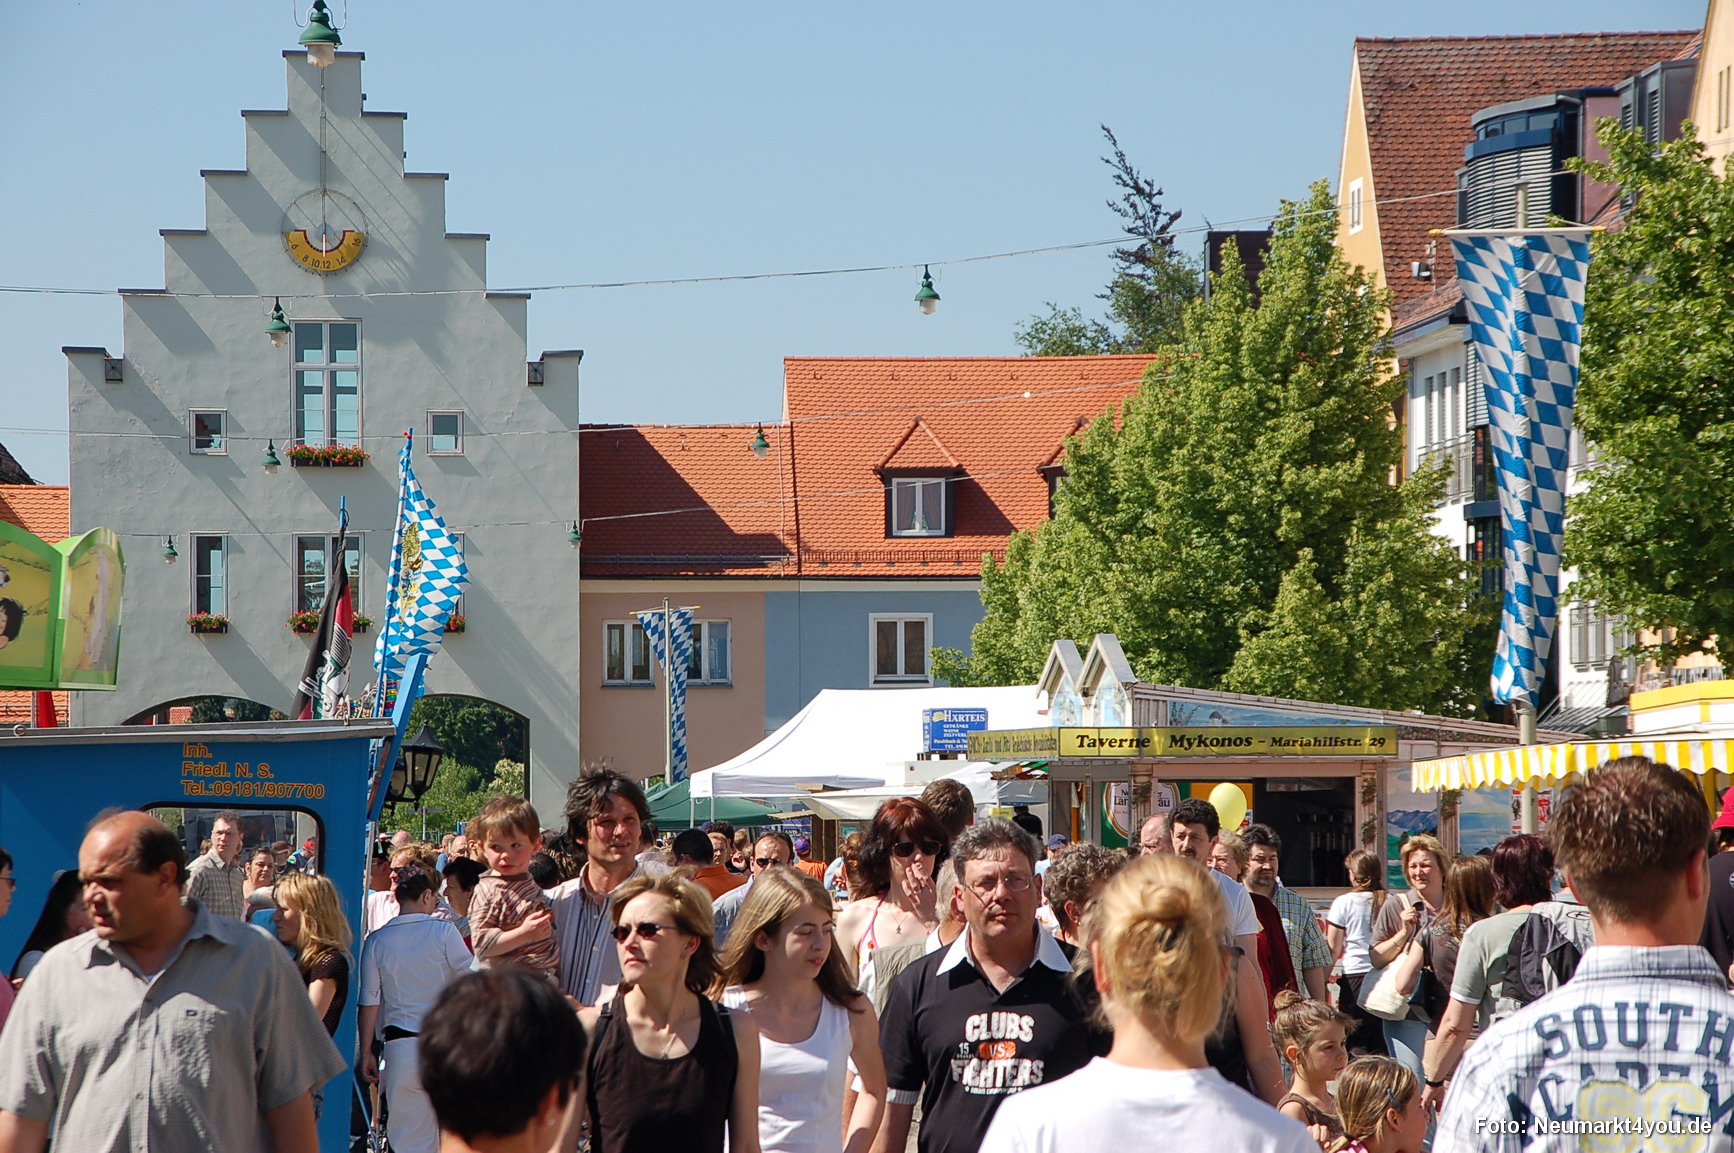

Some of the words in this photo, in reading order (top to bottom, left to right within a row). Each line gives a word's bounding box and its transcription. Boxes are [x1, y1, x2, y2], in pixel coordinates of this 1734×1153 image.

[302, 254, 309, 262] 8
[310, 258, 320, 268] 10
[322, 260, 331, 269] 12
[336, 256, 346, 266] 14
[352, 237, 361, 247] 16
[183, 742, 212, 758] Inh.
[1076, 734, 1150, 748] Taverne
[1168, 734, 1253, 751] Mykonos
[1270, 736, 1362, 747] Mariahilfstr.
[1369, 737, 1386, 748] 29
[182, 761, 230, 777] Friedl.
[235, 762, 253, 778] N.
[257, 763, 274, 779] S.
[181, 780, 325, 799] Tel.:09181/907700
[965, 1011, 1035, 1043] CLUBS
[1534, 1002, 1734, 1067] SOUTH
[958, 1042, 970, 1055] 15
[951, 1057, 1045, 1088] FIGHTERS
